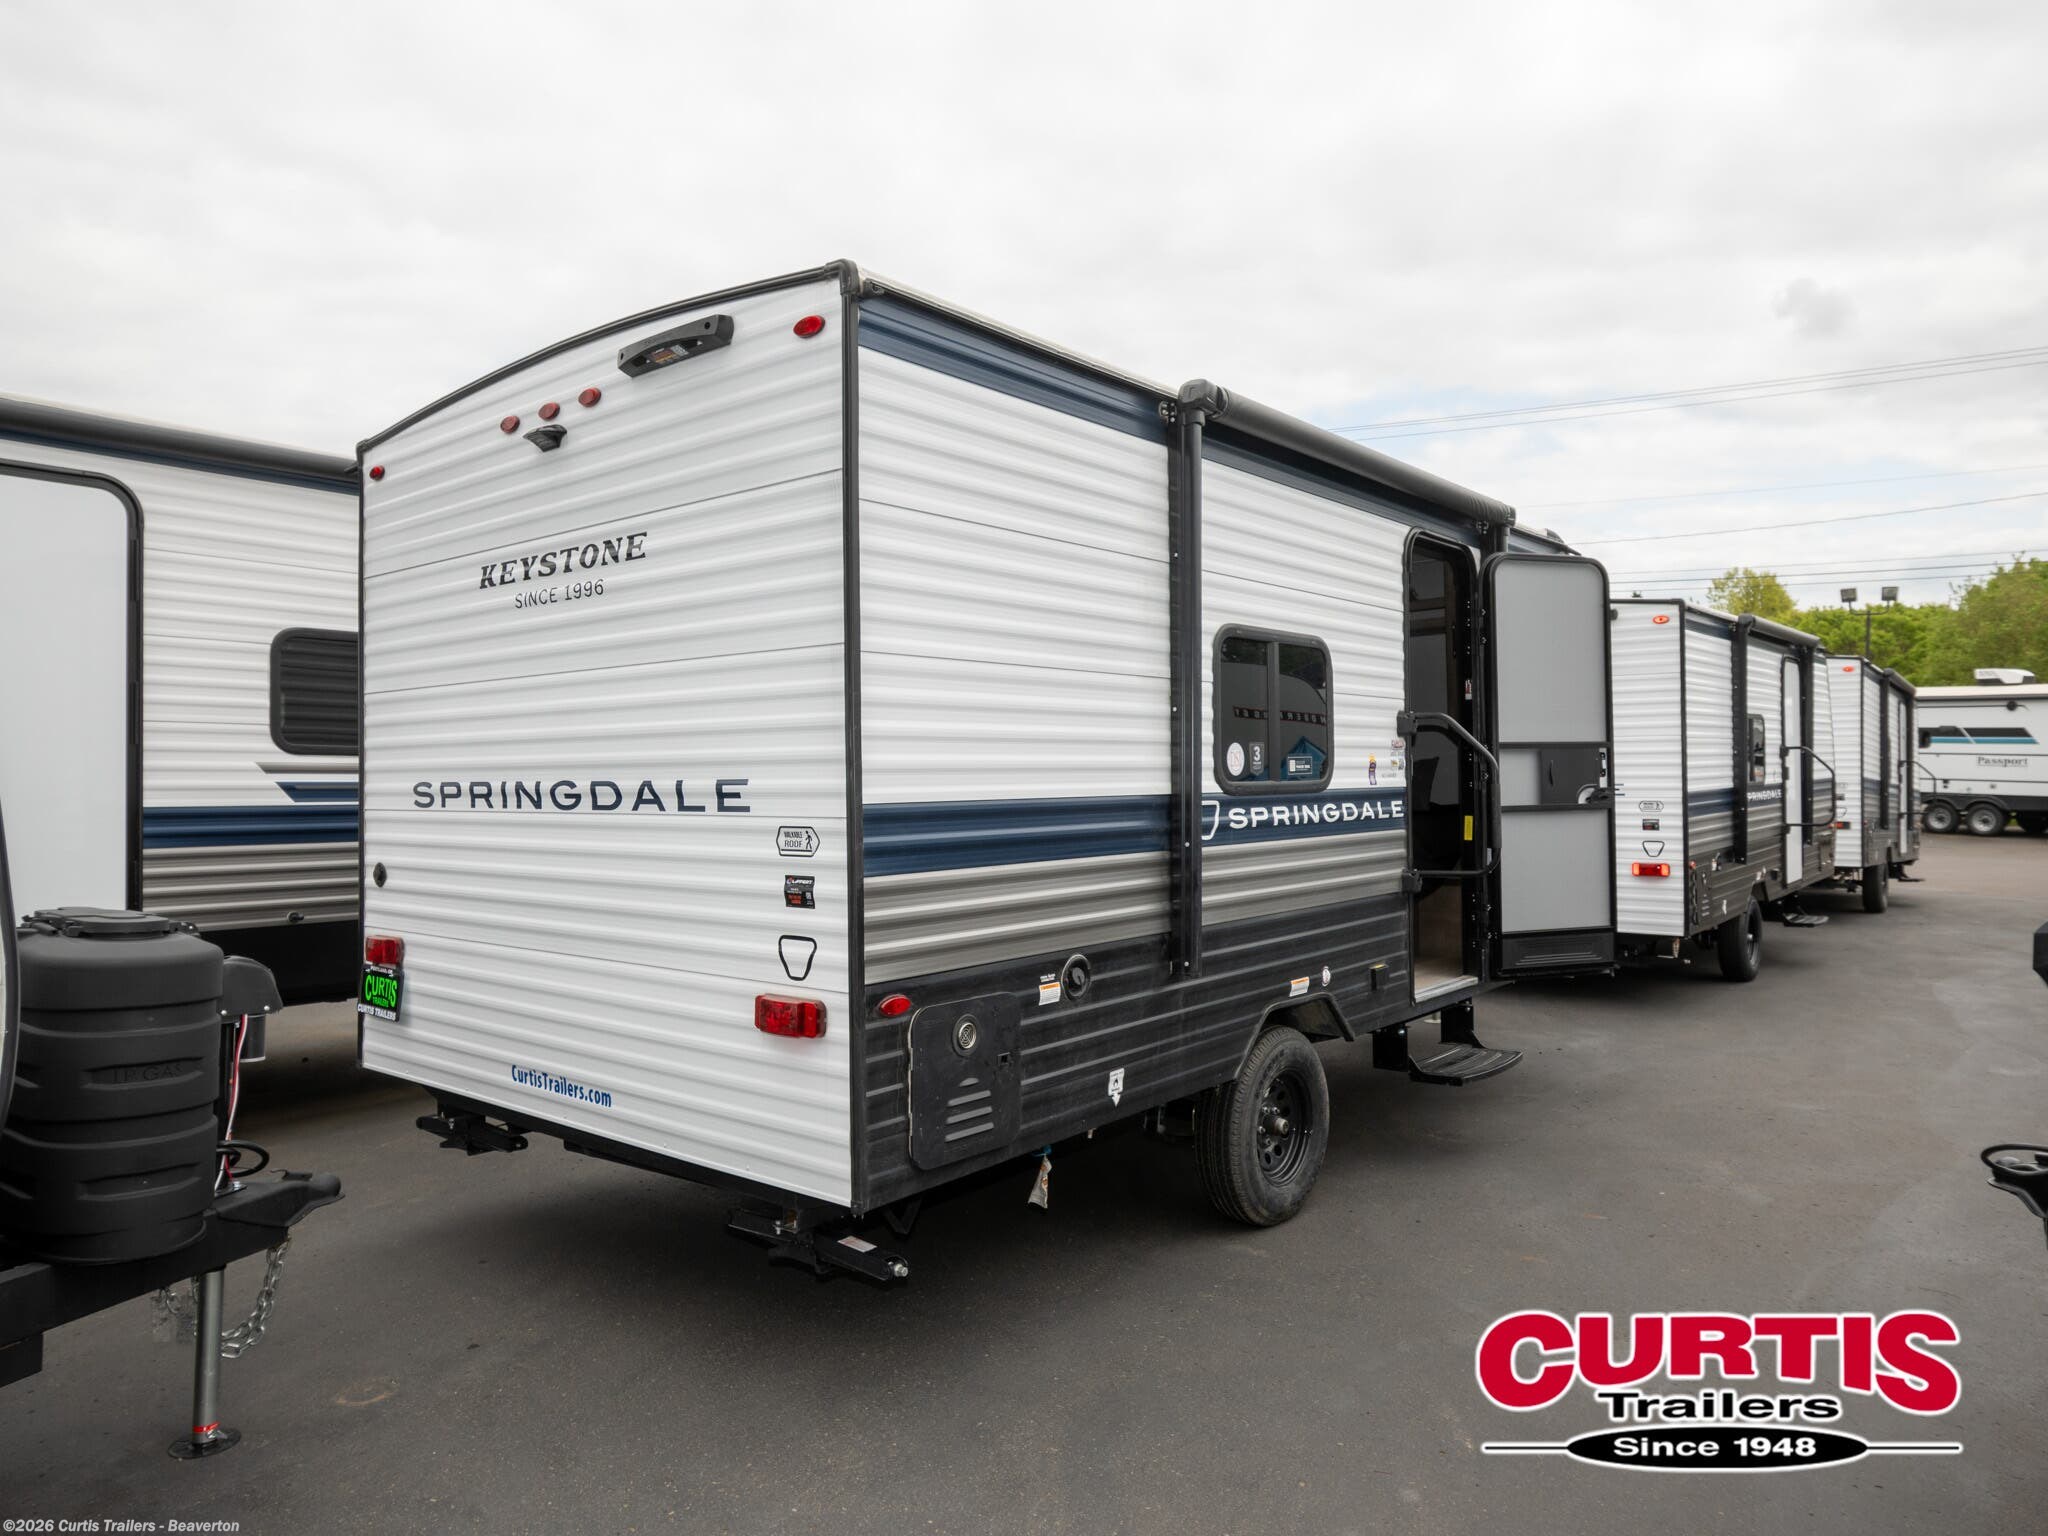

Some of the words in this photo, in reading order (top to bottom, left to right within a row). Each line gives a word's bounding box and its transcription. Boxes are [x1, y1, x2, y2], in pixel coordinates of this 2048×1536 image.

[479, 532, 648, 589] KEYSTONE
[515, 587, 558, 609] SINCE
[564, 579, 604, 601] 1996
[1253, 746, 1261, 762] 3
[1977, 756, 2028, 767] Passport
[413, 779, 751, 812] SPRINGDALE
[1228, 800, 1405, 829] SPRINGDALE
[784, 839, 803, 848] ROOF
[366, 975, 397, 1007] CURTIS
[358, 1004, 374, 1014] CURTIS
[375, 1008, 396, 1021] TRAILERS
[511, 1064, 612, 1108] CurtisTrailers.com
